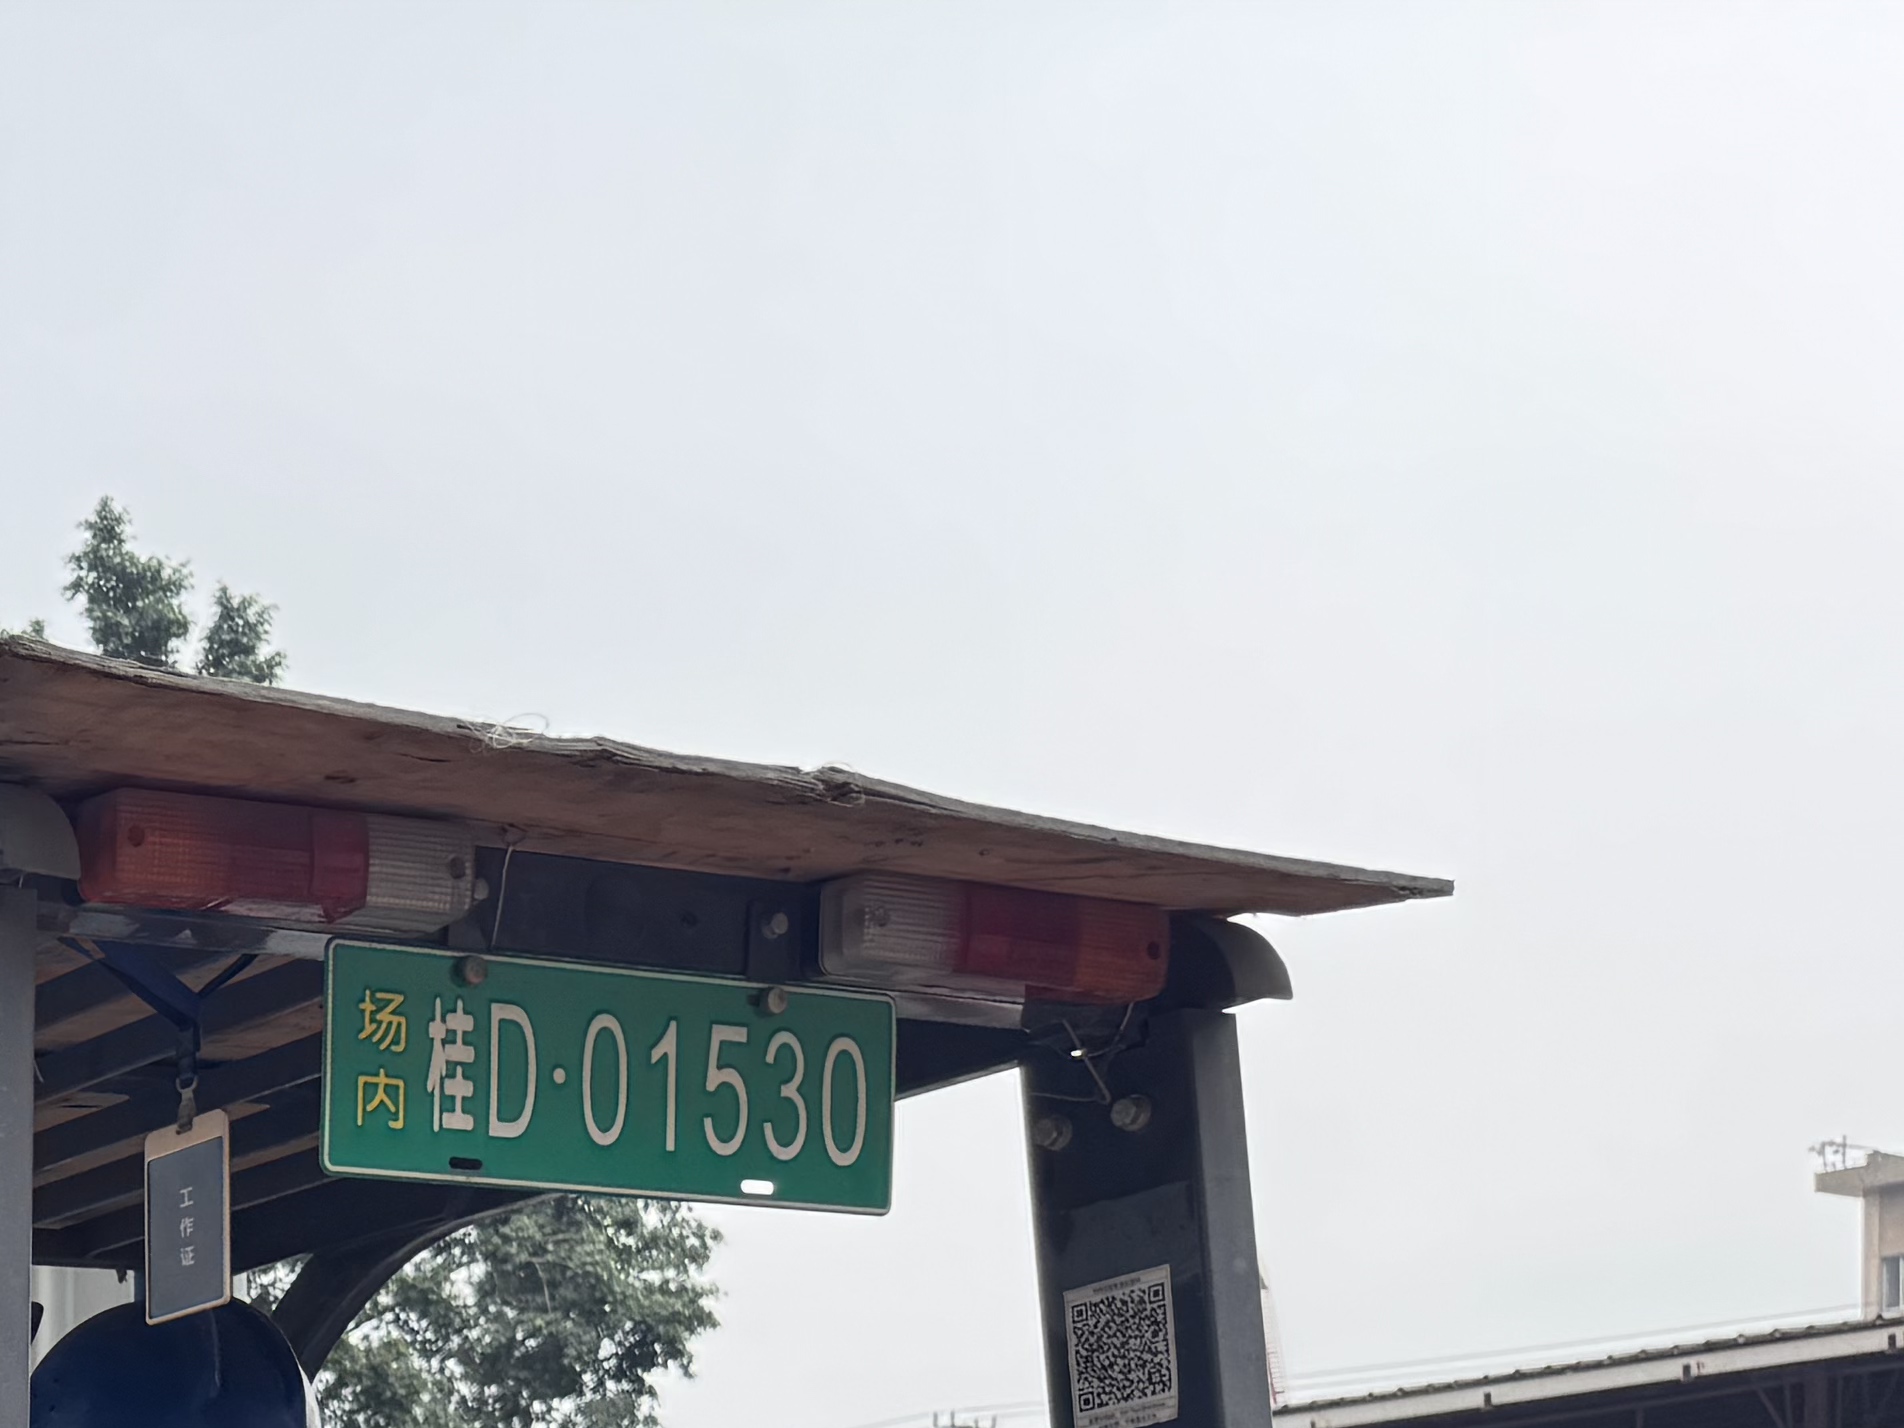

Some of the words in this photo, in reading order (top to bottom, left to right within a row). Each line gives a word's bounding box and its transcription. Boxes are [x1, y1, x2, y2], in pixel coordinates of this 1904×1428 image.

[357, 988, 408, 1132] 场内
[178, 1186, 196, 1269] 工作证
